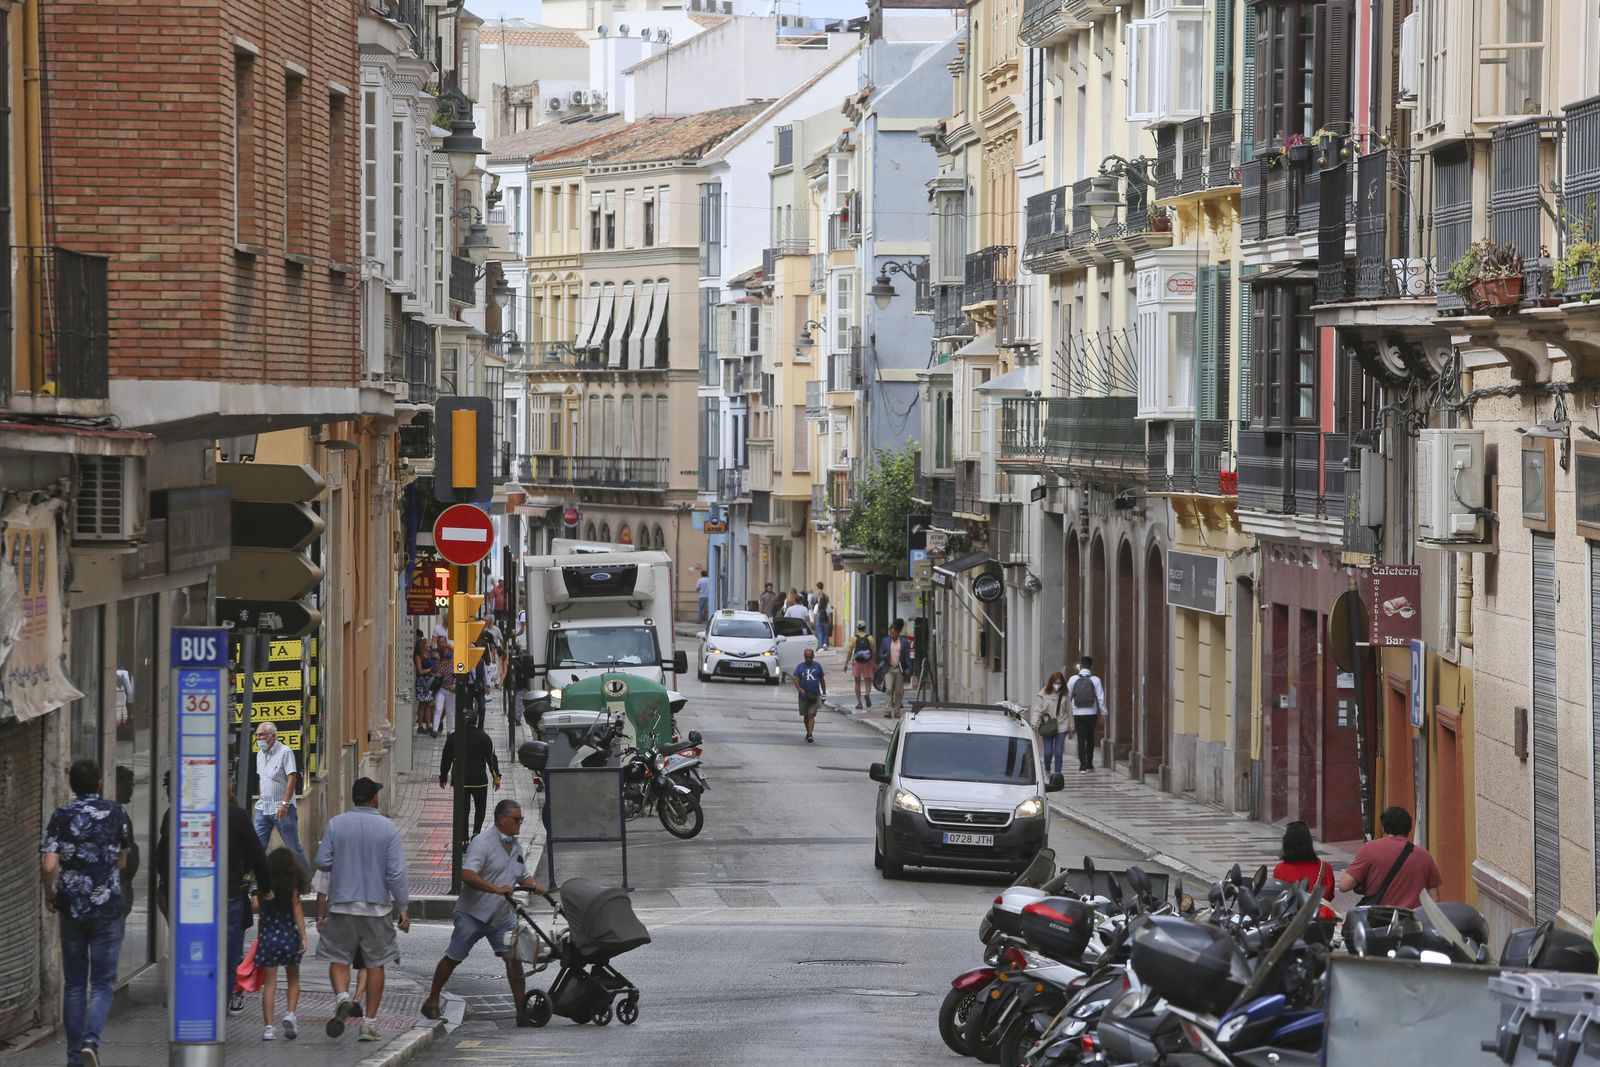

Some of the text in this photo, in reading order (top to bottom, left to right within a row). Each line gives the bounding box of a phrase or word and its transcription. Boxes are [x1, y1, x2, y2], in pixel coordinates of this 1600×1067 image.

[1384, 635, 1404, 645] Bar
[180, 636, 217, 662] BUS
[186, 694, 211, 712] 36
[949, 834, 992, 844] 0728 JTH
